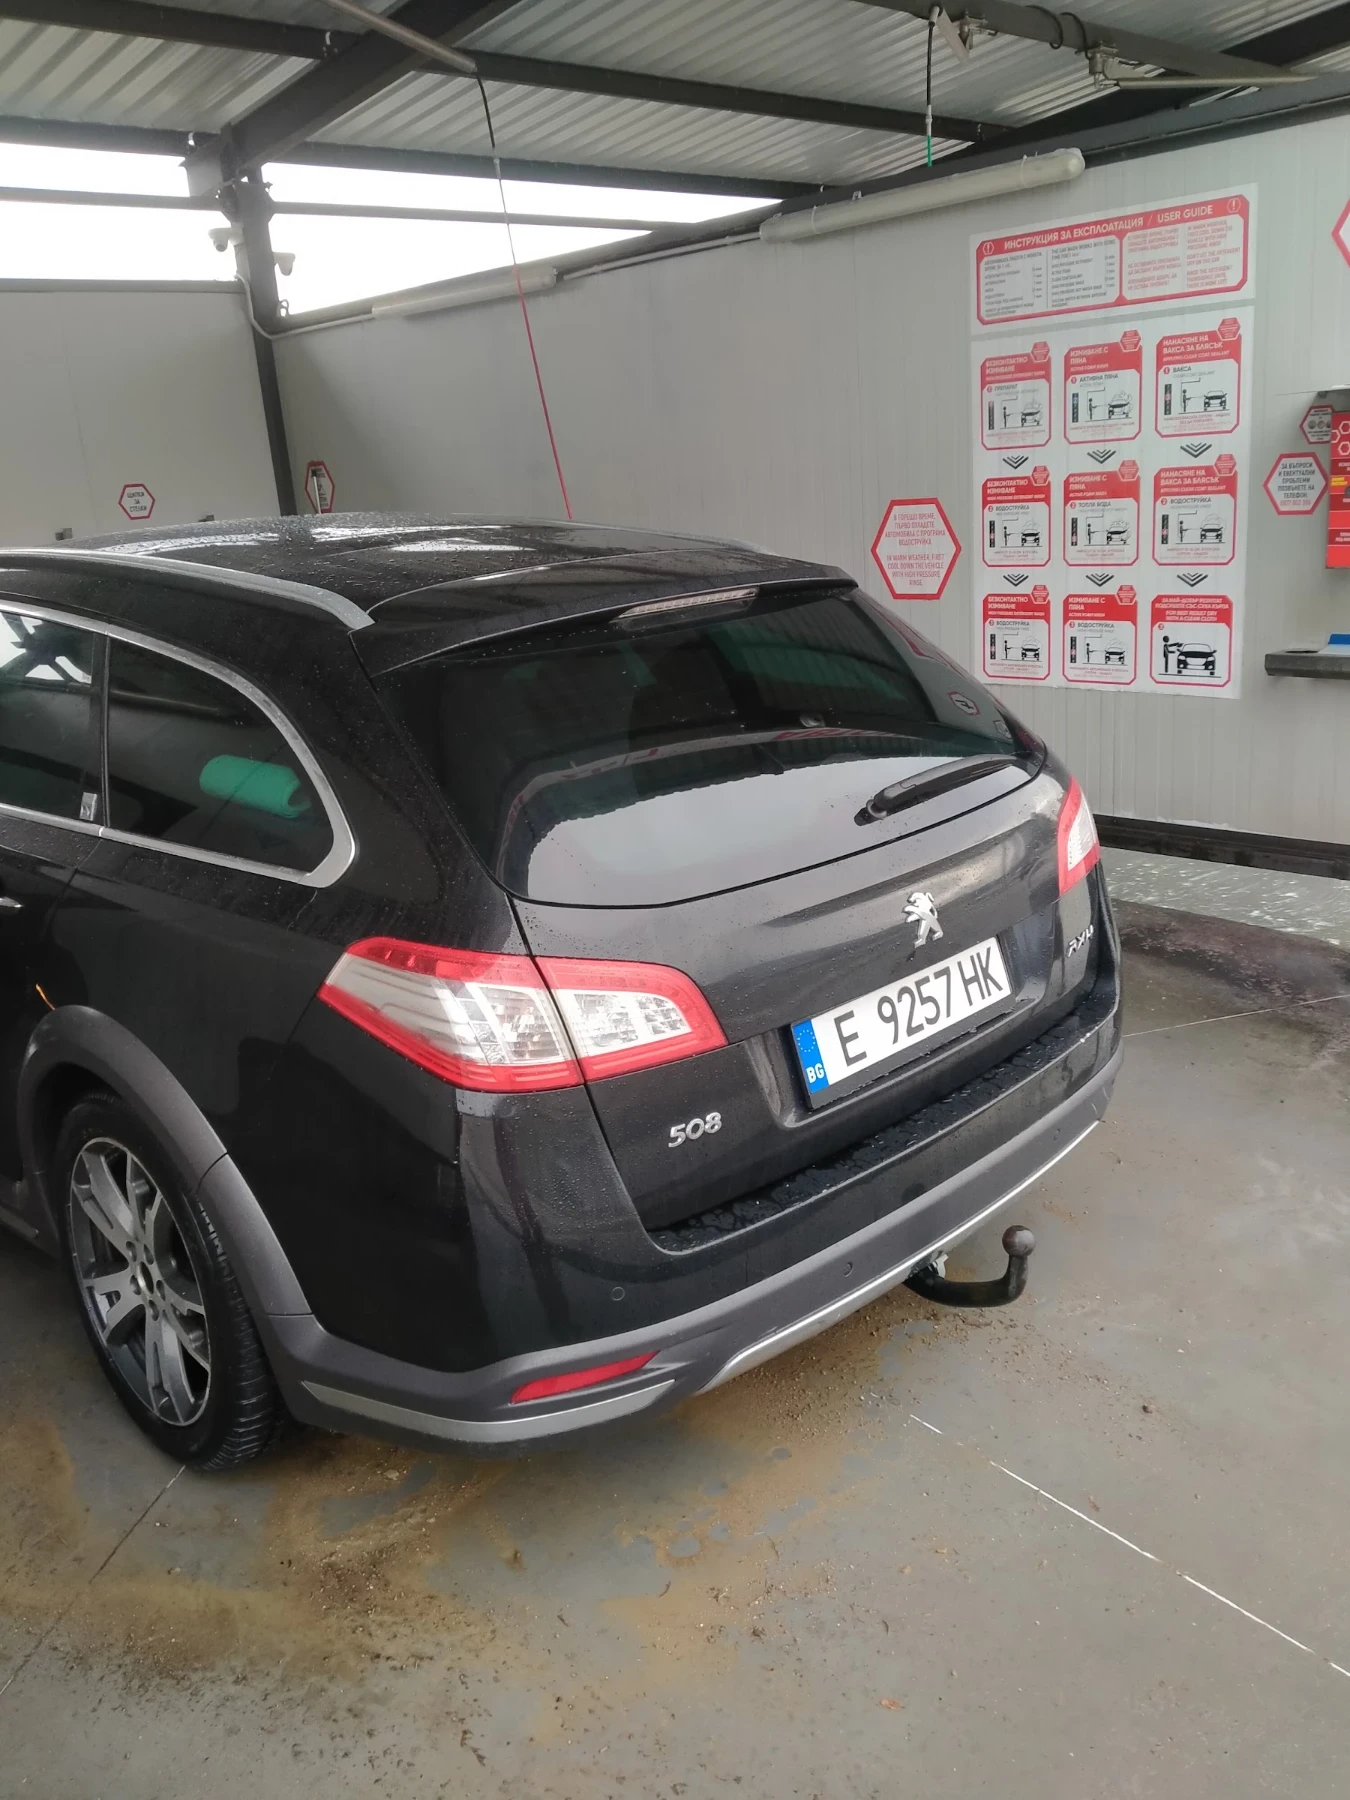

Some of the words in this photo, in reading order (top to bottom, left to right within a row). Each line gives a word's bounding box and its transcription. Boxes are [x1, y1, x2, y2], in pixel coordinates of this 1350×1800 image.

[1004, 232, 1059, 250] ИНСТРУКЦИЯ
[1060, 230, 1072, 240] ЗА
[1074, 217, 1144, 237] ЕКСПЛОАТАЦИЯ
[1157, 211, 1181, 223] USER
[1183, 205, 1213, 218] GUIDE
[1163, 336, 1198, 346] НАНАСЯНЕ
[1070, 348, 1102, 357] ИЗМИВАНЕ
[1163, 346, 1185, 354] ВАКСА
[1196, 342, 1223, 350] БЛЯСЪК
[986, 357, 1028, 367] БЕЗКОНТАКТНО
[1070, 357, 1086, 365] ПЯНА
[986, 365, 1015, 374] ИЗМИВАНЕ
[987, 479, 1028, 488] БЕЗКОНТАКТНО
[1070, 475, 1101, 483] ИЗМИВАНЕ
[912, 521, 935, 529] ОХЛАДЕТЕ
[899, 538, 932, 546] ВОДОСТРУЙКА
[1068, 924, 1094, 958] RXH
[834, 1010, 868, 1068] E
[877, 966, 952, 1045] 9257
[957, 946, 1003, 1006] HK
[806, 1066, 825, 1084] BG
[668, 1112, 722, 1148] 508
